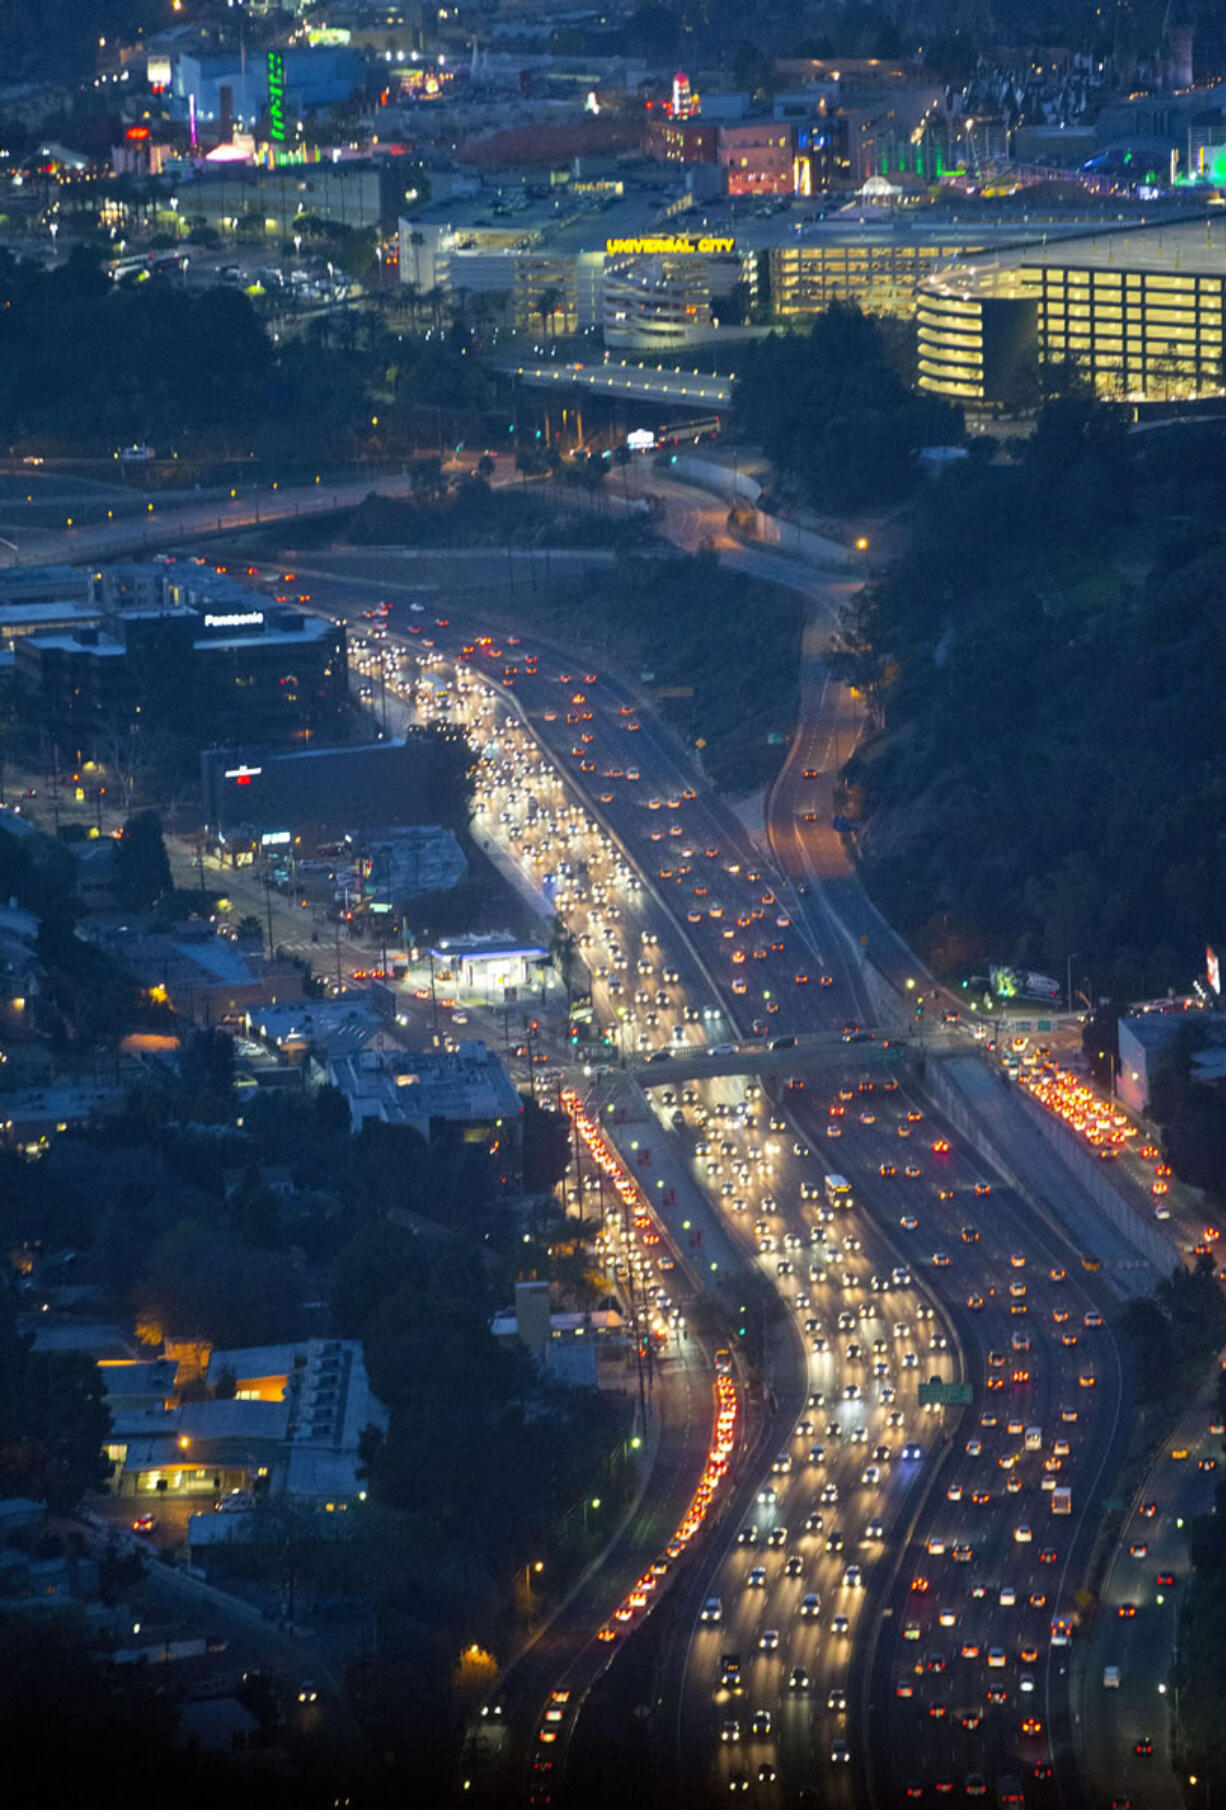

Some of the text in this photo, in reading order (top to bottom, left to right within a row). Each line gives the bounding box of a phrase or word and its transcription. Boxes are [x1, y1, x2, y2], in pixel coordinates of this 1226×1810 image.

[606, 238, 735, 254] UNIVERSAL CITY
[205, 612, 263, 626] Panasonic
